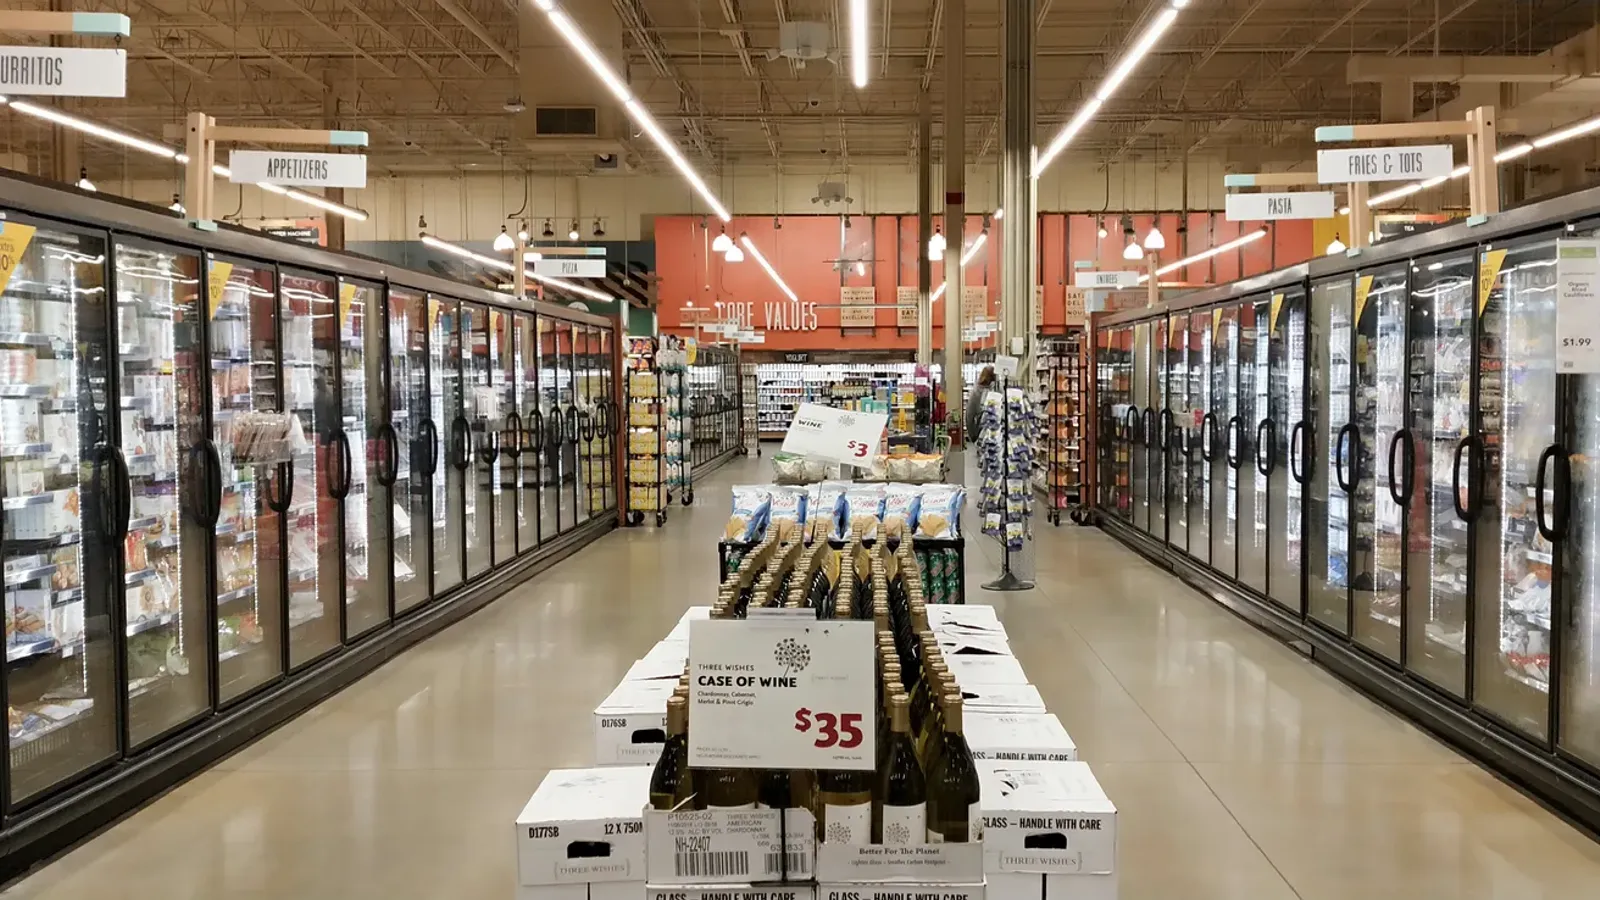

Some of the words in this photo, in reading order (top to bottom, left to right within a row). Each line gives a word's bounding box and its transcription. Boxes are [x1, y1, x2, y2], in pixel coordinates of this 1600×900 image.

[0, 55, 63, 86] URRITOS
[267, 157, 328, 180] APPETIZERS
[1349, 154, 1378, 176] FRIES
[1383, 153, 1394, 175] &
[1399, 152, 1423, 174] TOTS
[1267, 197, 1293, 215] PASTA
[764, 301, 818, 331] VALUES
[1563, 337, 1592, 347] $1.99
[798, 419, 823, 428] WINE
[848, 440, 868, 457] $3
[698, 663, 722, 671] THREE
[725, 664, 755, 672] WISHES
[698, 675, 733, 687] CASE
[736, 676, 756, 687] OF
[759, 677, 797, 688] WINE
[737, 699, 754, 707] Grigio
[795, 707, 863, 748] $35
[604, 823, 614, 835] 12
[616, 823, 622, 834] X
[1019, 818, 1053, 829] HANDLE
[1055, 818, 1077, 830] WITH
[1079, 819, 1102, 830] CARE
[528, 826, 560, 839] D177SB
[675, 836, 711, 852] NH-22407
[1004, 856, 1039, 865] THREE
[1040, 857, 1077, 866] WISHES
[560, 866, 588, 874] THREE
[591, 865, 625, 873] WISHES
